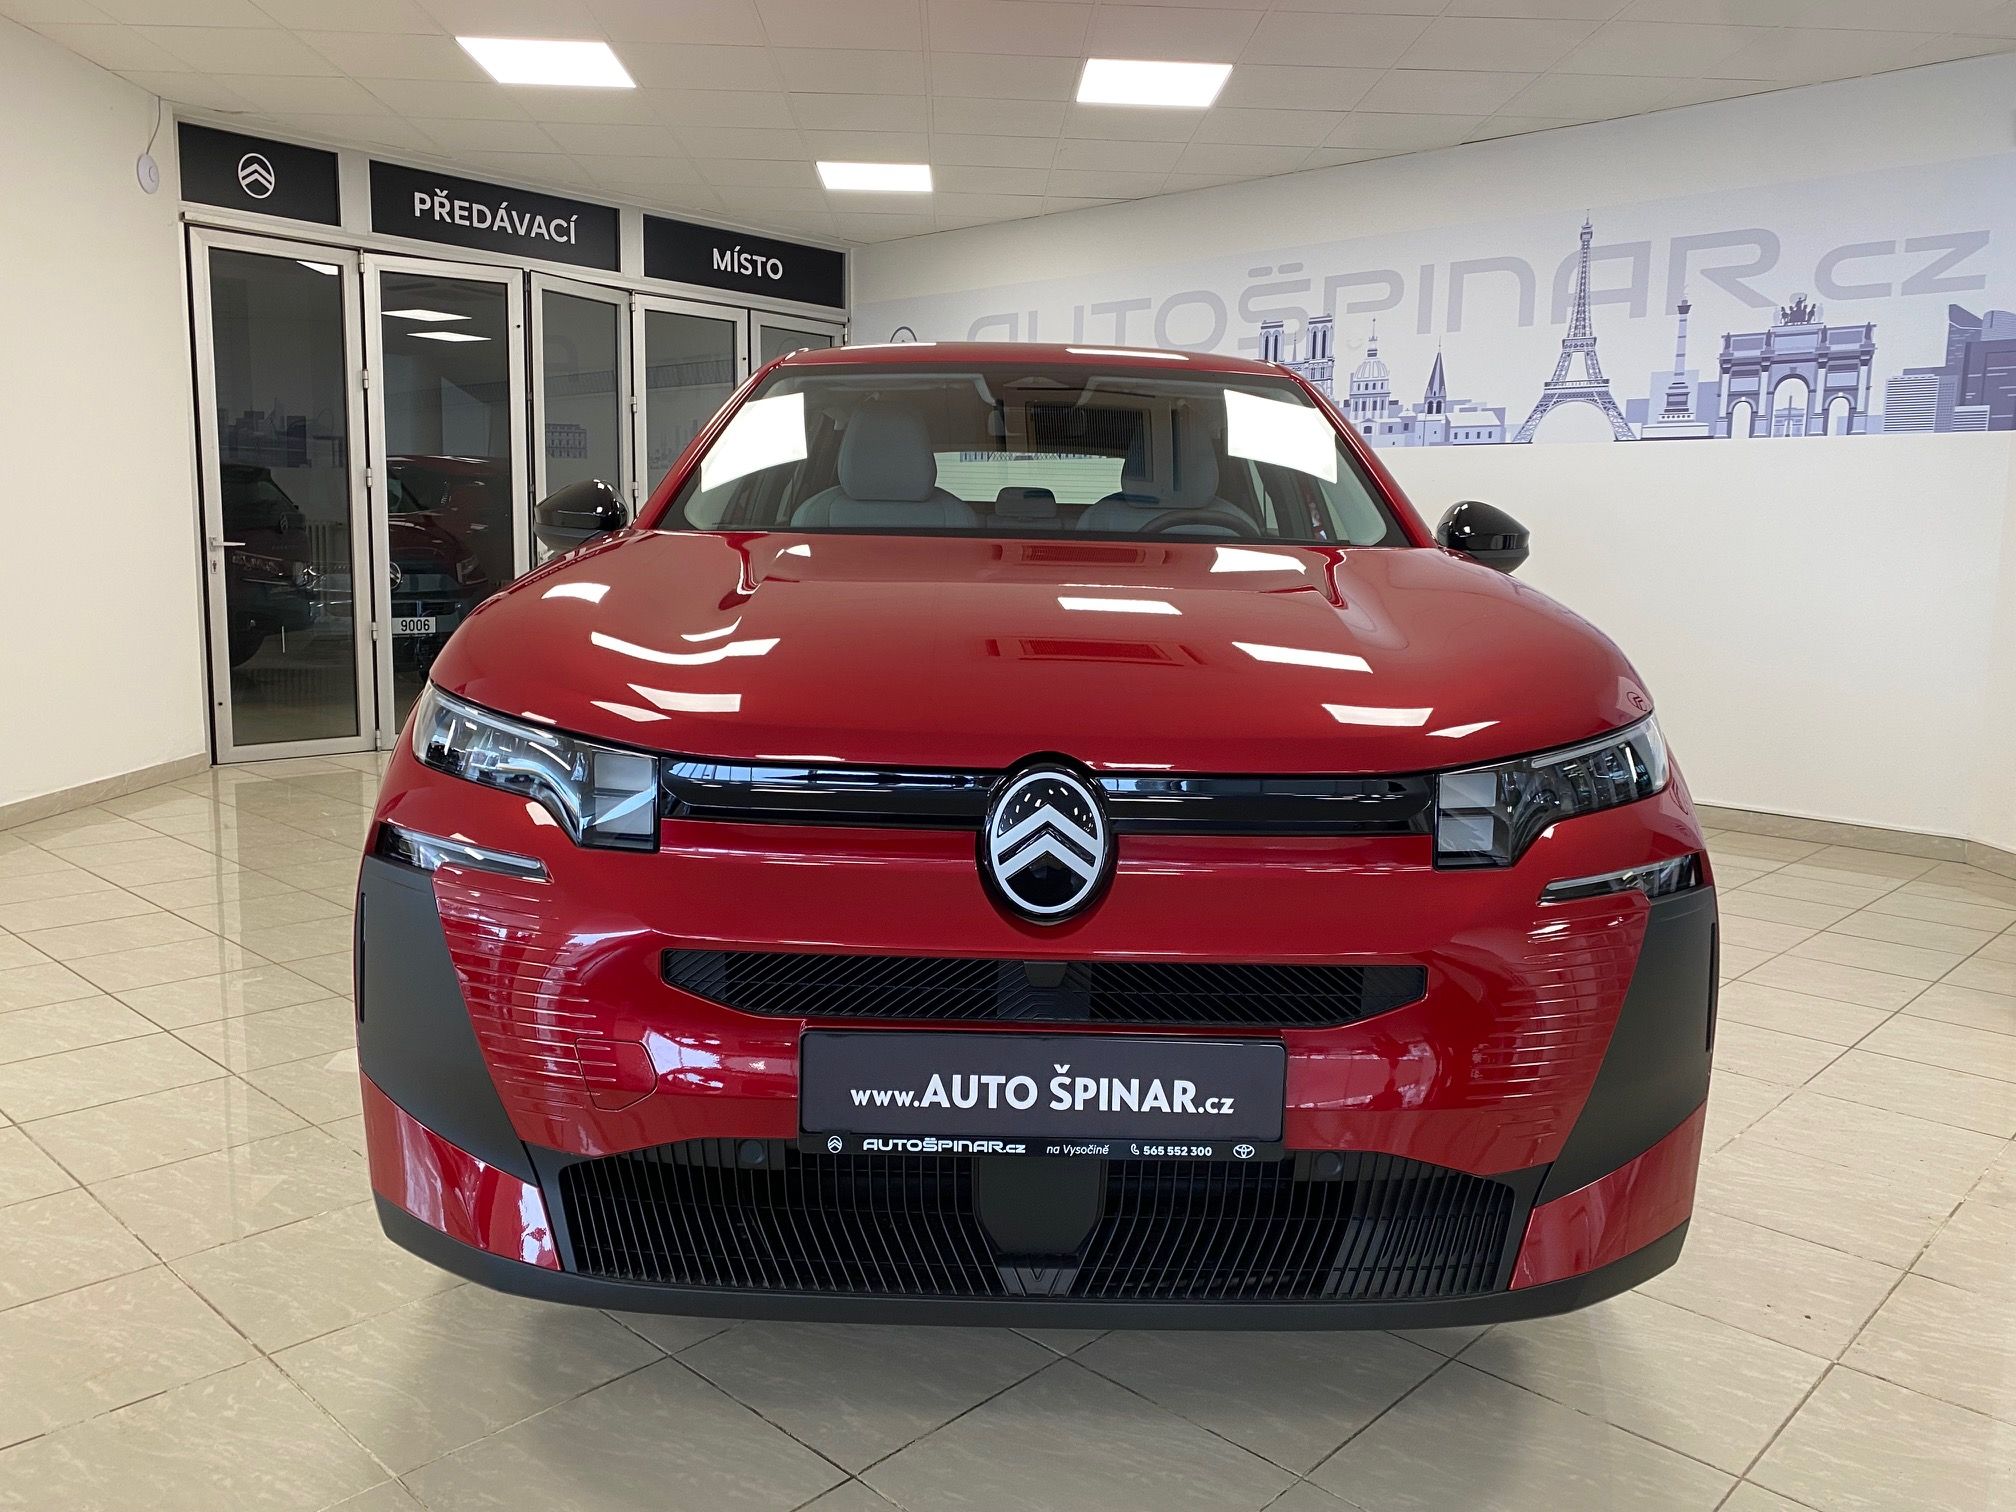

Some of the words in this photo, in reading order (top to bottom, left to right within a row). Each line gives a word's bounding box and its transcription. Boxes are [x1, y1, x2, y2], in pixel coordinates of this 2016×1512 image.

[413, 189, 578, 244] PŘEDÁVACÍ
[712, 246, 784, 280] MÍSTO
[400, 618, 430, 632] 9006
[850, 1073, 1038, 1110] www.AUTO
[1050, 1064, 1235, 1115] ŠPINAR.cz
[862, 1137, 1026, 1154] AUTOŠPINAR.cz
[1046, 1145, 1061, 1155] na
[1063, 1143, 1109, 1156] Vysočině
[1143, 1145, 1165, 1156] 565
[1166, 1146, 1188, 1157] 552
[1190, 1146, 1213, 1157] 300
